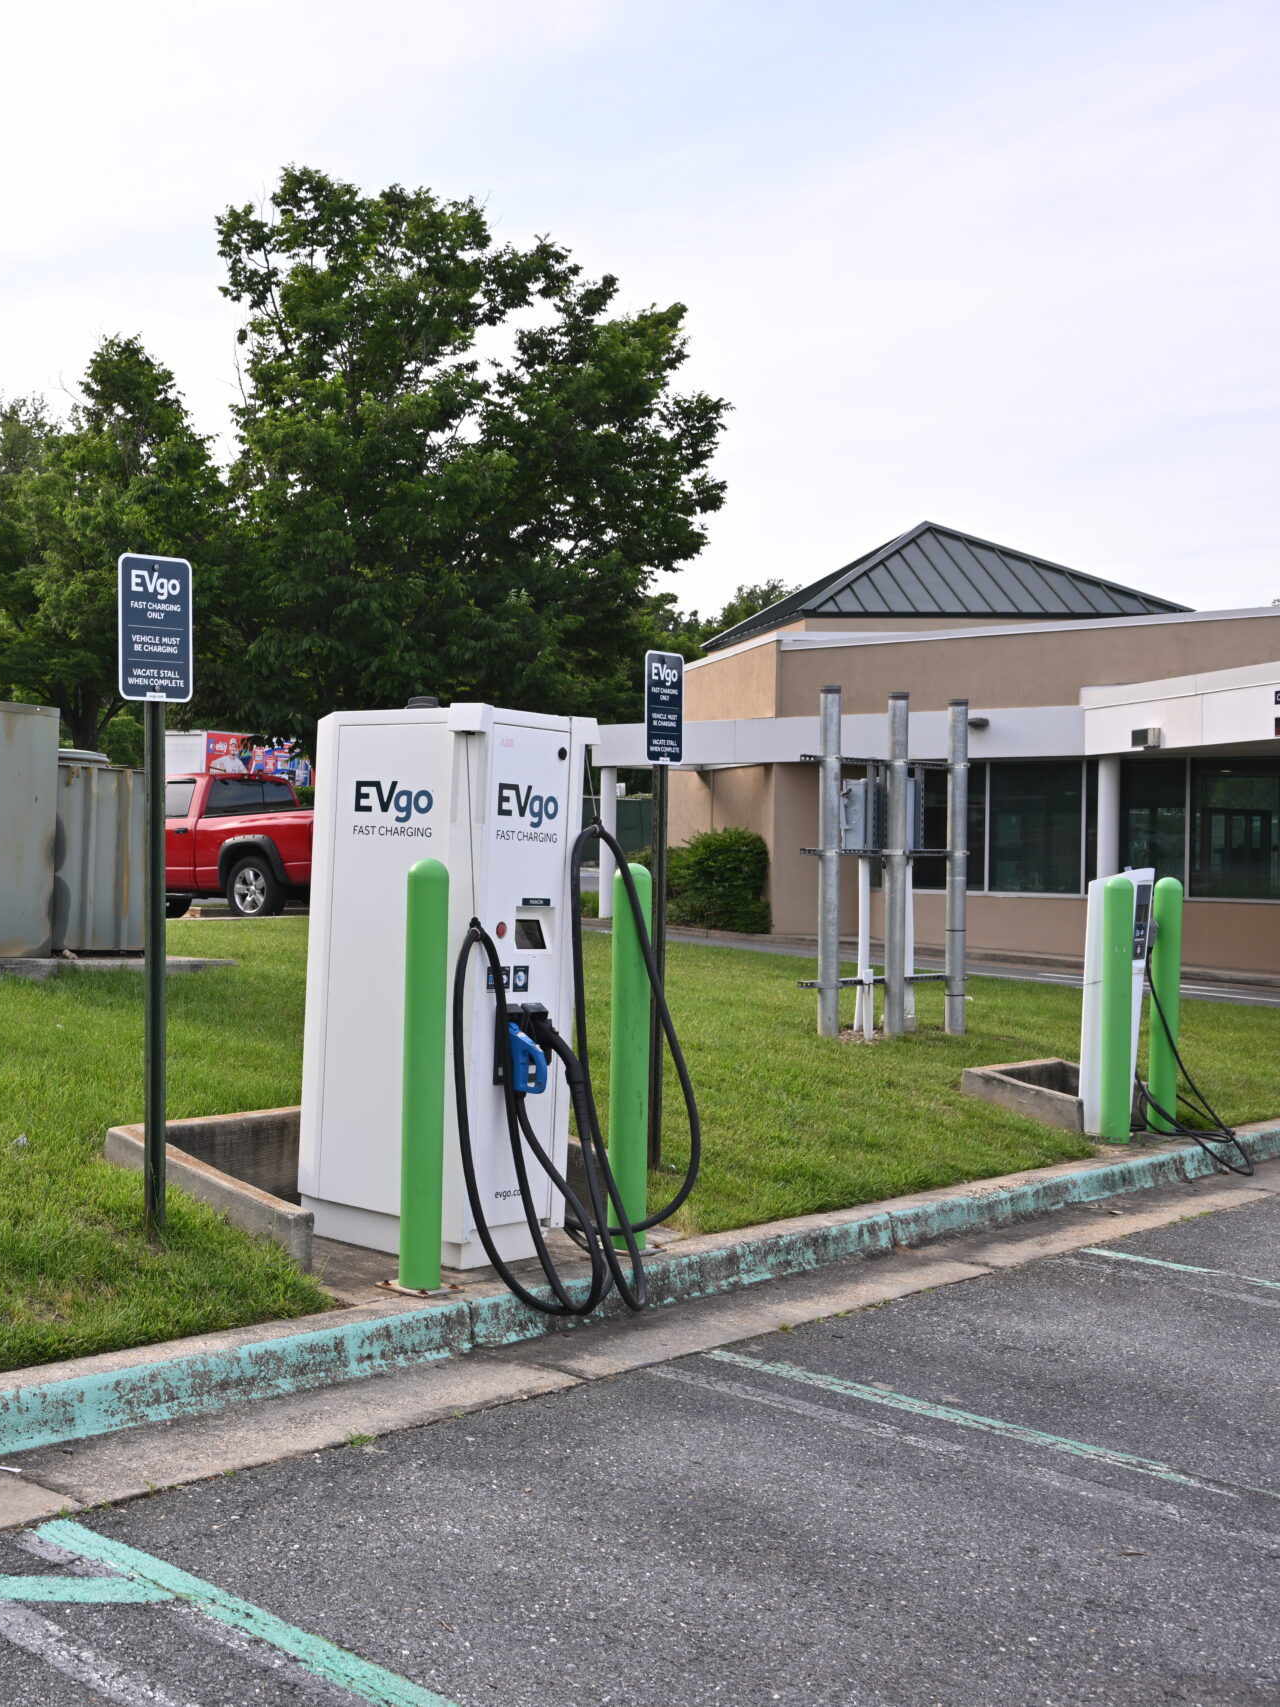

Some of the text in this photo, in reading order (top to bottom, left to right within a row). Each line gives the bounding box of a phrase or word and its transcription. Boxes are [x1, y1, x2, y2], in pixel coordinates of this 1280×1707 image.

[131, 569, 180, 600] EVgo
[130, 601, 181, 612] FAST CHARGING
[147, 611, 164, 619] ONLY
[132, 635, 180, 645] VEHICLE MUST
[134, 643, 178, 653] BE CHARGING
[133, 668, 180, 678] VACATE STALL
[651, 662, 678, 686] EVgo
[128, 677, 184, 687] WHEN COMPLETE
[354, 780, 433, 823] EVgo
[497, 783, 559, 828] EVgo
[352, 825, 432, 838] FAST CHARGING
[496, 829, 558, 843] FAST CHARGING
[494, 1189, 521, 1200] evgo.co
